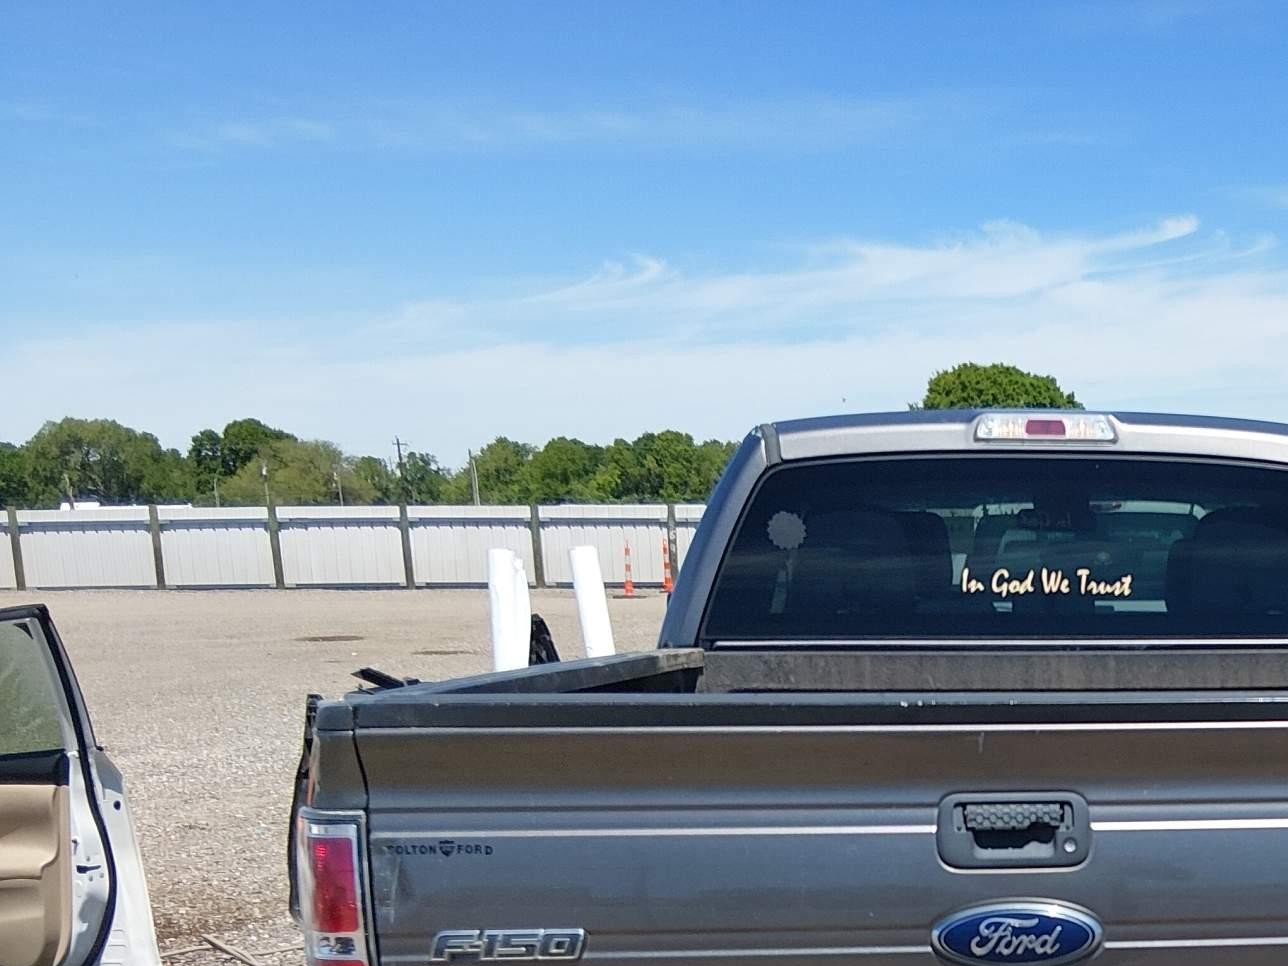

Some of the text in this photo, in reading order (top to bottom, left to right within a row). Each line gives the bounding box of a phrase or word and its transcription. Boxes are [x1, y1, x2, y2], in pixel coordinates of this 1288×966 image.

[961, 567, 1132, 598] In God We Trust
[456, 844, 494, 856] FORD
[970, 916, 1063, 957] Ford
